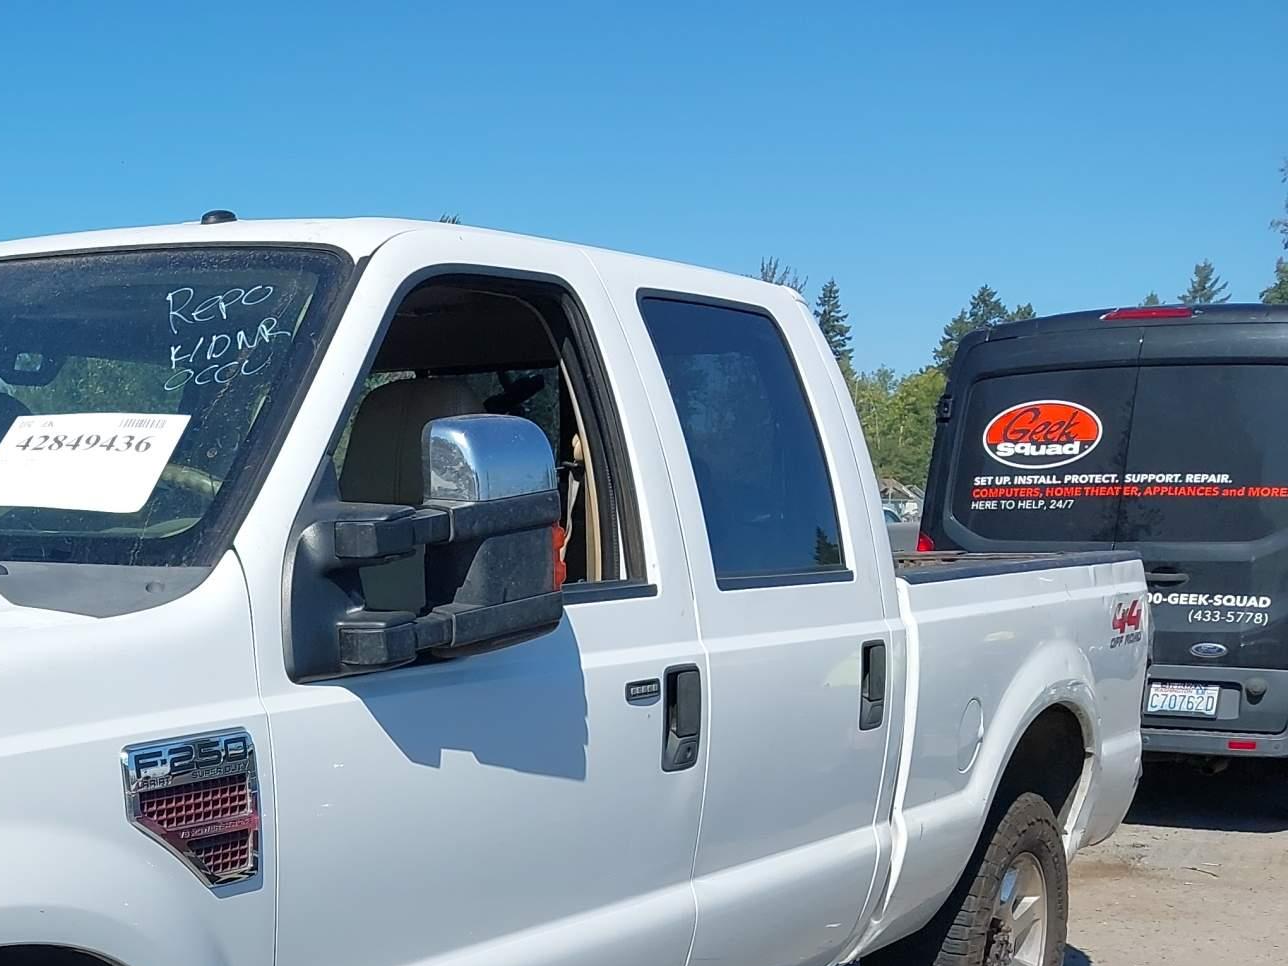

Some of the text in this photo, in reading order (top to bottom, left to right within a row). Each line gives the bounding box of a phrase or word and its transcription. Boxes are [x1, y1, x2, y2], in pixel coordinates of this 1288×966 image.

[1003, 407, 1080, 443] Geek
[16, 434, 155, 453] 42849436
[974, 473, 1233, 485] SET UP. INSTALL. PROTECT. SUPPORT. REPAIR.
[972, 487, 1043, 498] COMPUTERS,
[1045, 487, 1081, 497] HOME
[1143, 486, 1219, 496] APPLIANCES
[1221, 487, 1245, 496] and
[971, 500, 1074, 511] HERE TO HELP, 24/7
[1188, 609, 1269, 626] (433-5778)
[1150, 694, 1215, 711] C70762D
[134, 737, 248, 780] F-250
[192, 767, 223, 779] SUPER
